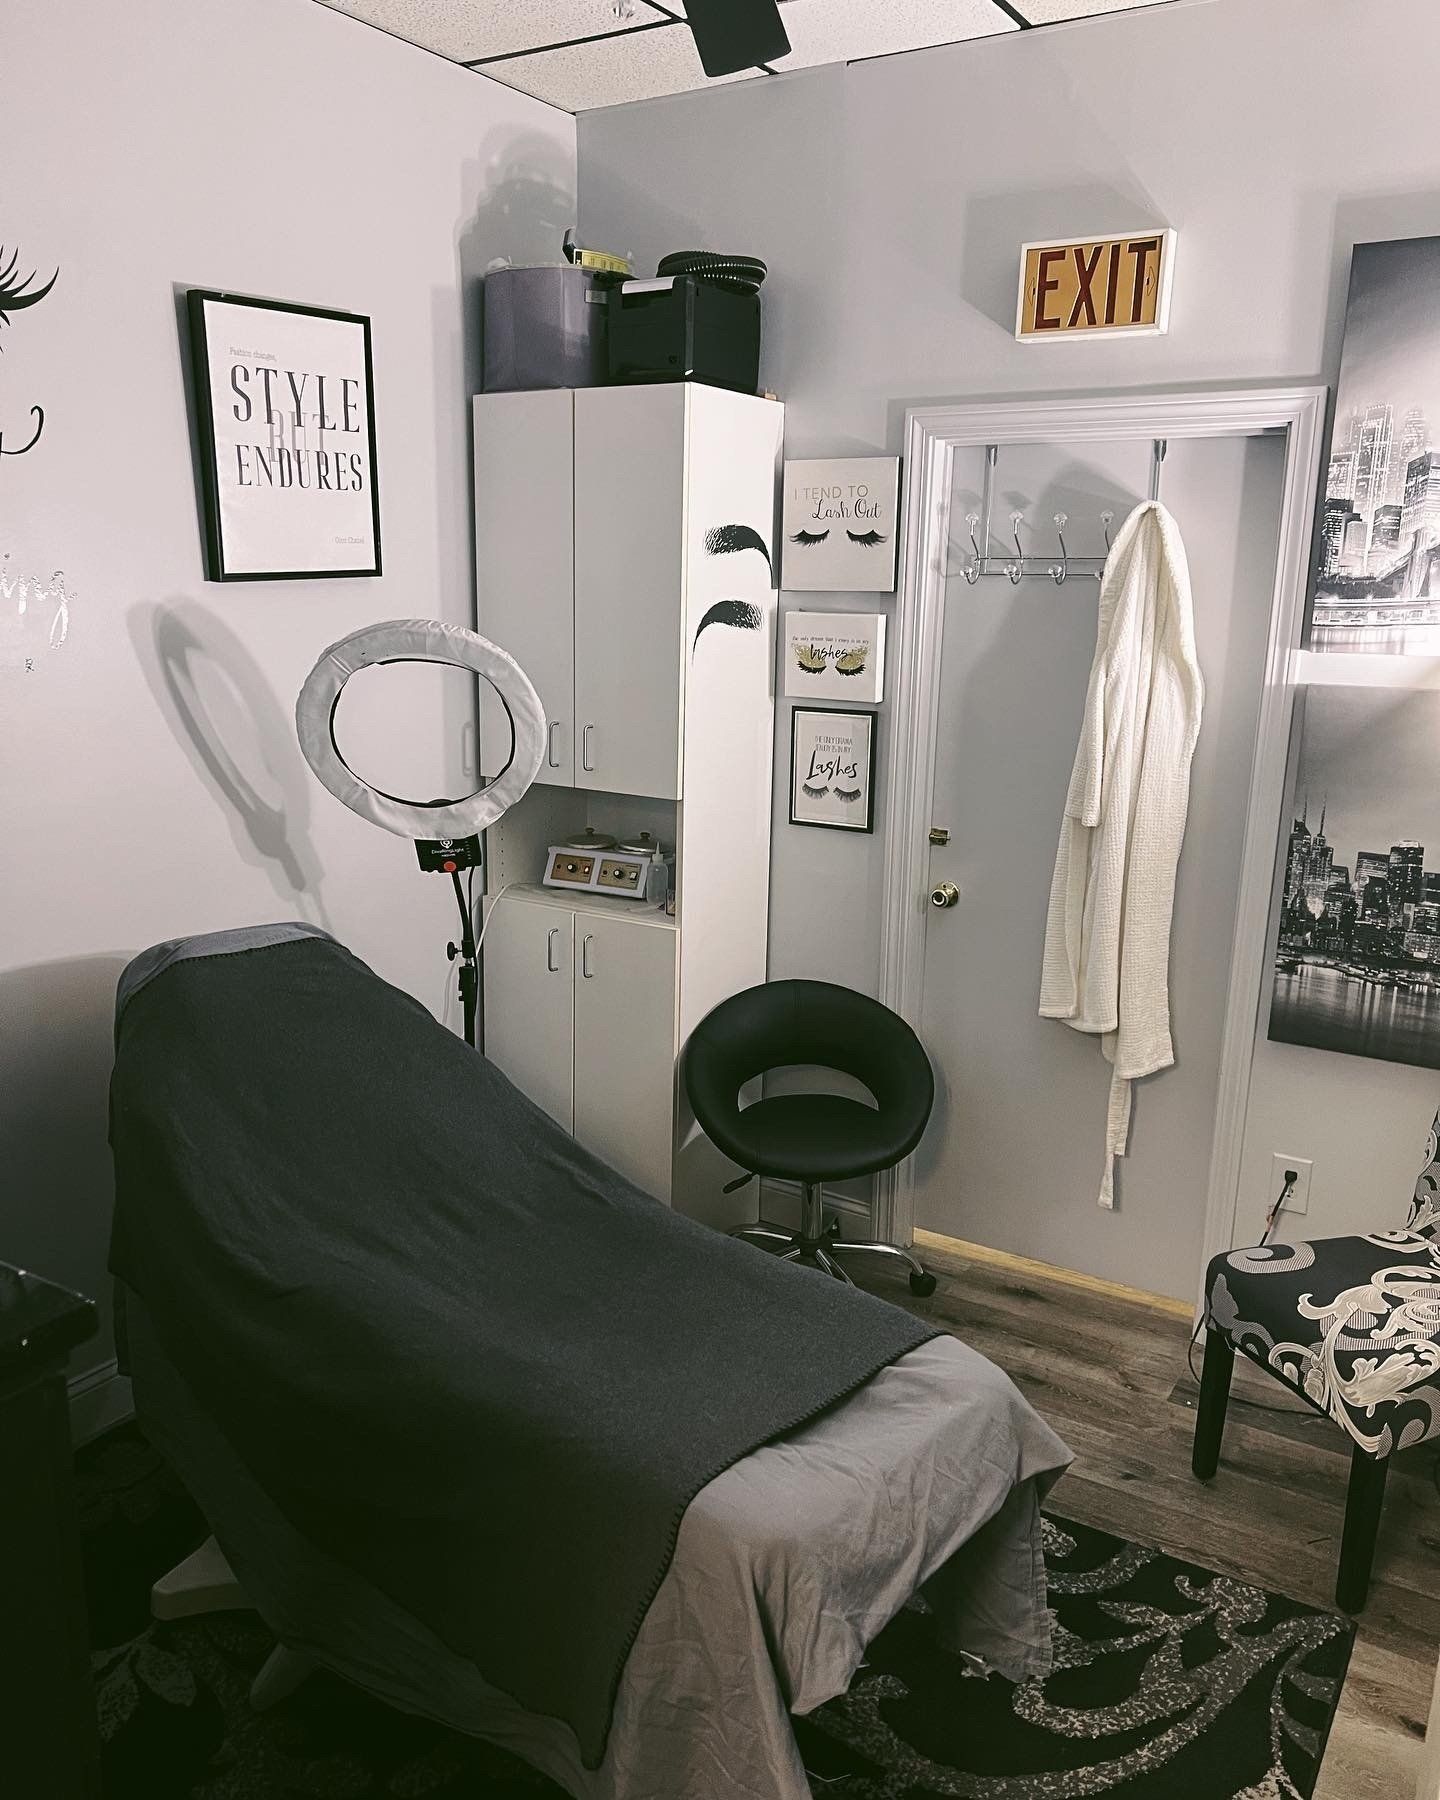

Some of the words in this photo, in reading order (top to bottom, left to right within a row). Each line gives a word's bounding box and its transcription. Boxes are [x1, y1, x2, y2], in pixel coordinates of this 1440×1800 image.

[1034, 239, 1158, 330] EXIT
[230, 364, 360, 433] STYLE
[269, 409, 330, 465] BUT
[234, 444, 363, 492] ENDURES
[803, 486, 842, 500] TEND
[847, 485, 868, 498] TO
[811, 498, 851, 520] Lash
[854, 498, 882, 519] Out
[810, 643, 852, 662] lashes
[805, 749, 858, 781] Lashes
